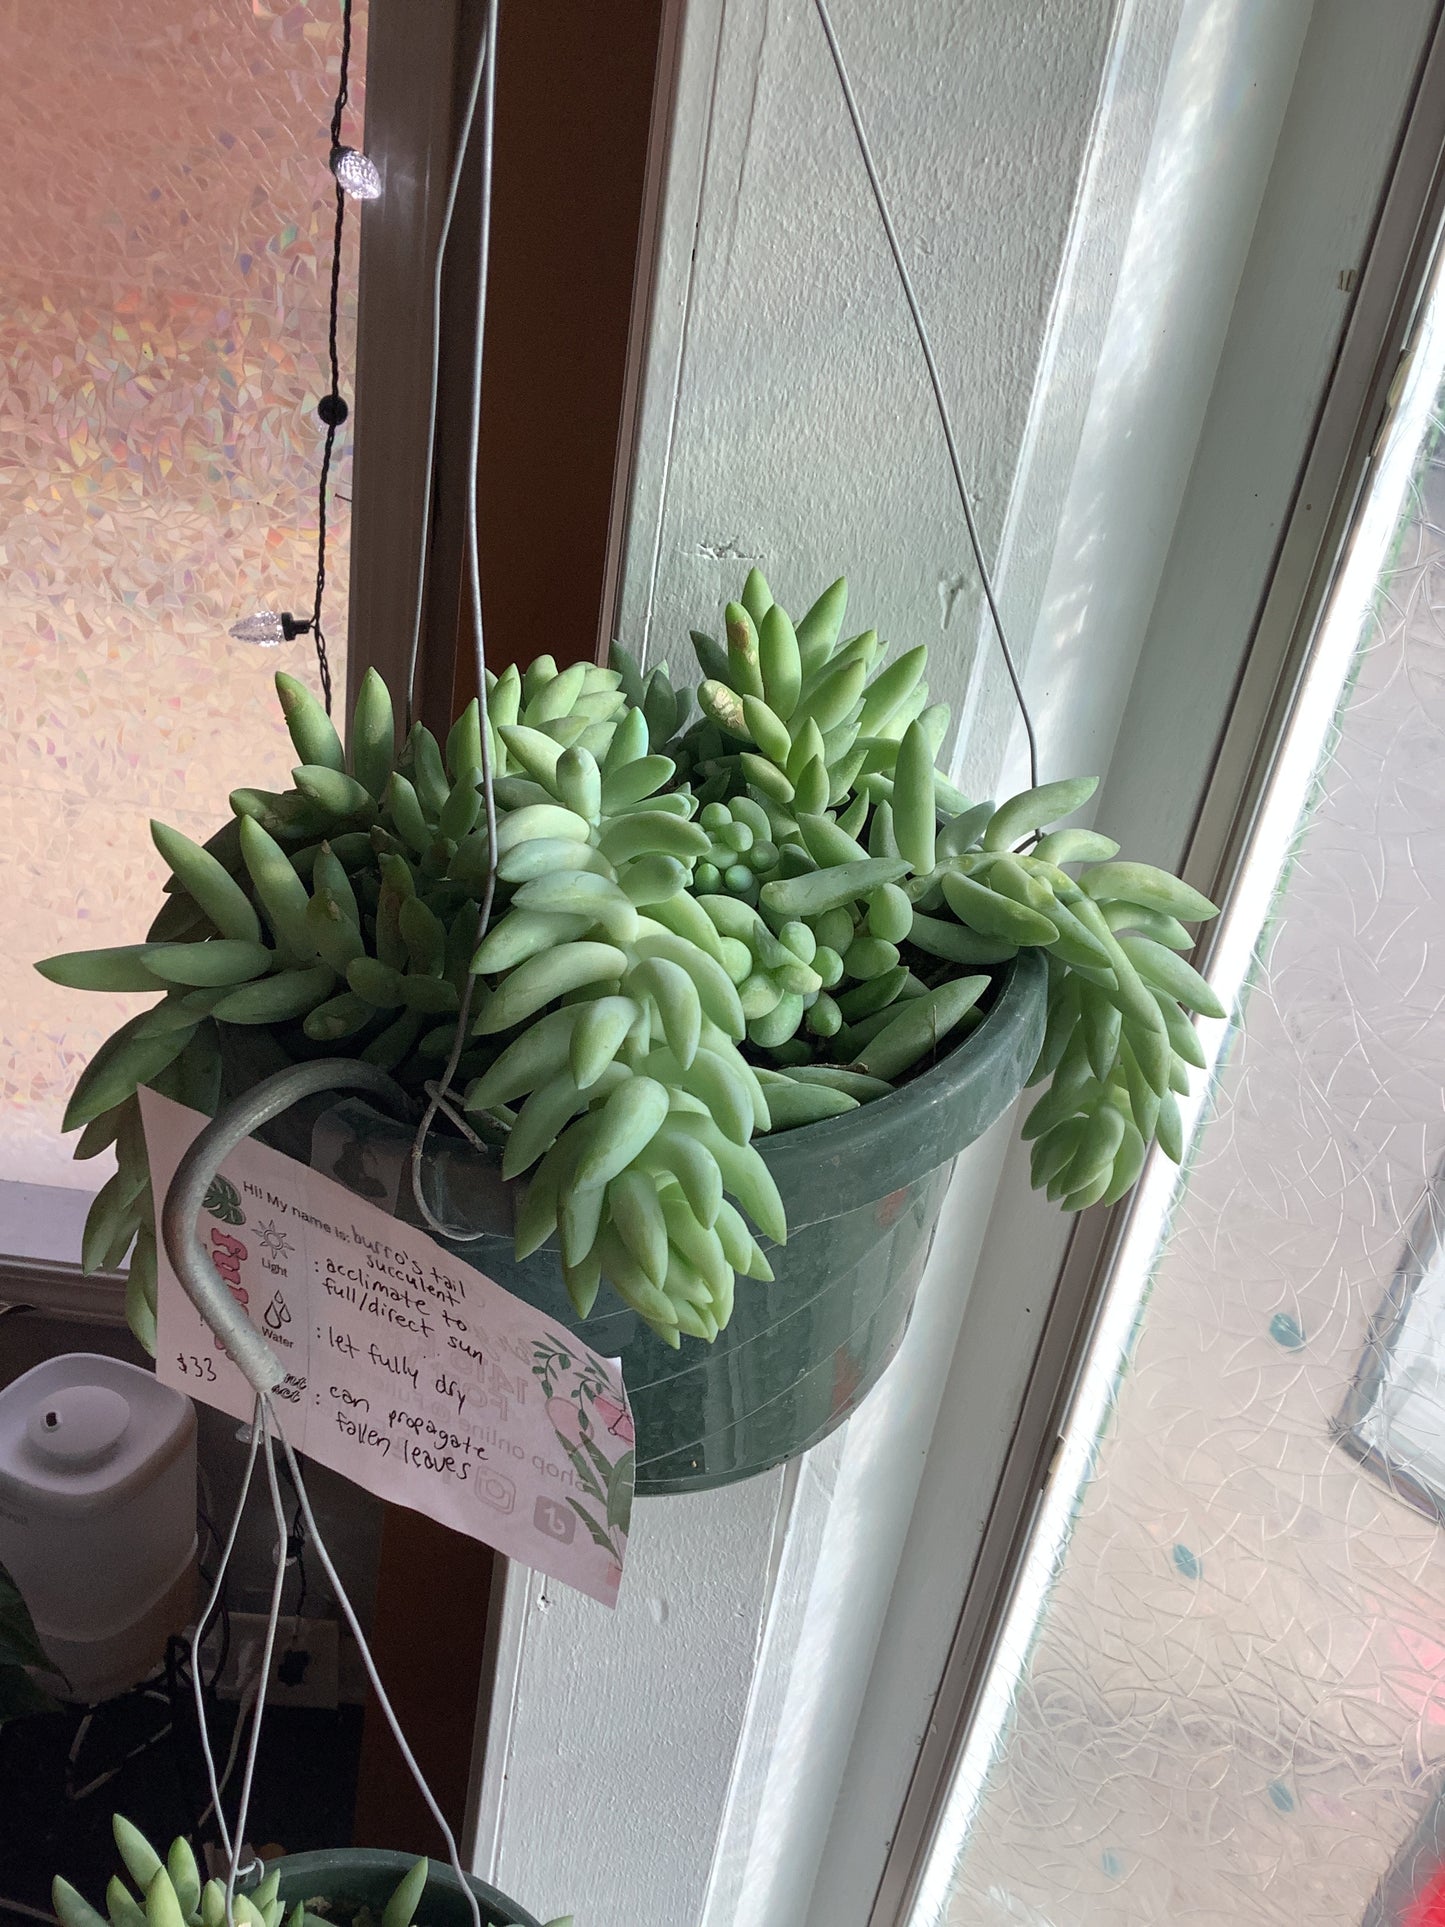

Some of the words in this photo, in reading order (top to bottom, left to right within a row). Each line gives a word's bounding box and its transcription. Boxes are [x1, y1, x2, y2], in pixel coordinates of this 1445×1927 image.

[243, 1181, 263, 1199] Hi!
[267, 1192, 288, 1213] My
[292, 1206, 332, 1234] name
[351, 1224, 423, 1275] burro's
[430, 1266, 466, 1298] tail
[261, 1257, 289, 1278] Light
[326, 1258, 430, 1316] acclimate
[442, 1310, 468, 1332] to
[366, 1254, 461, 1307] succulent
[261, 1326, 294, 1348] Water
[322, 1277, 435, 1338] full/direct
[447, 1335, 483, 1365] sun
[177, 1353, 217, 1381] $33
[329, 1326, 360, 1359] let
[368, 1343, 419, 1389] fully
[435, 1374, 466, 1415] dry
[330, 1385, 370, 1413] can
[388, 1410, 489, 1460] propagate
[336, 1411, 391, 1457] fallen
[404, 1439, 472, 1480] leaves
